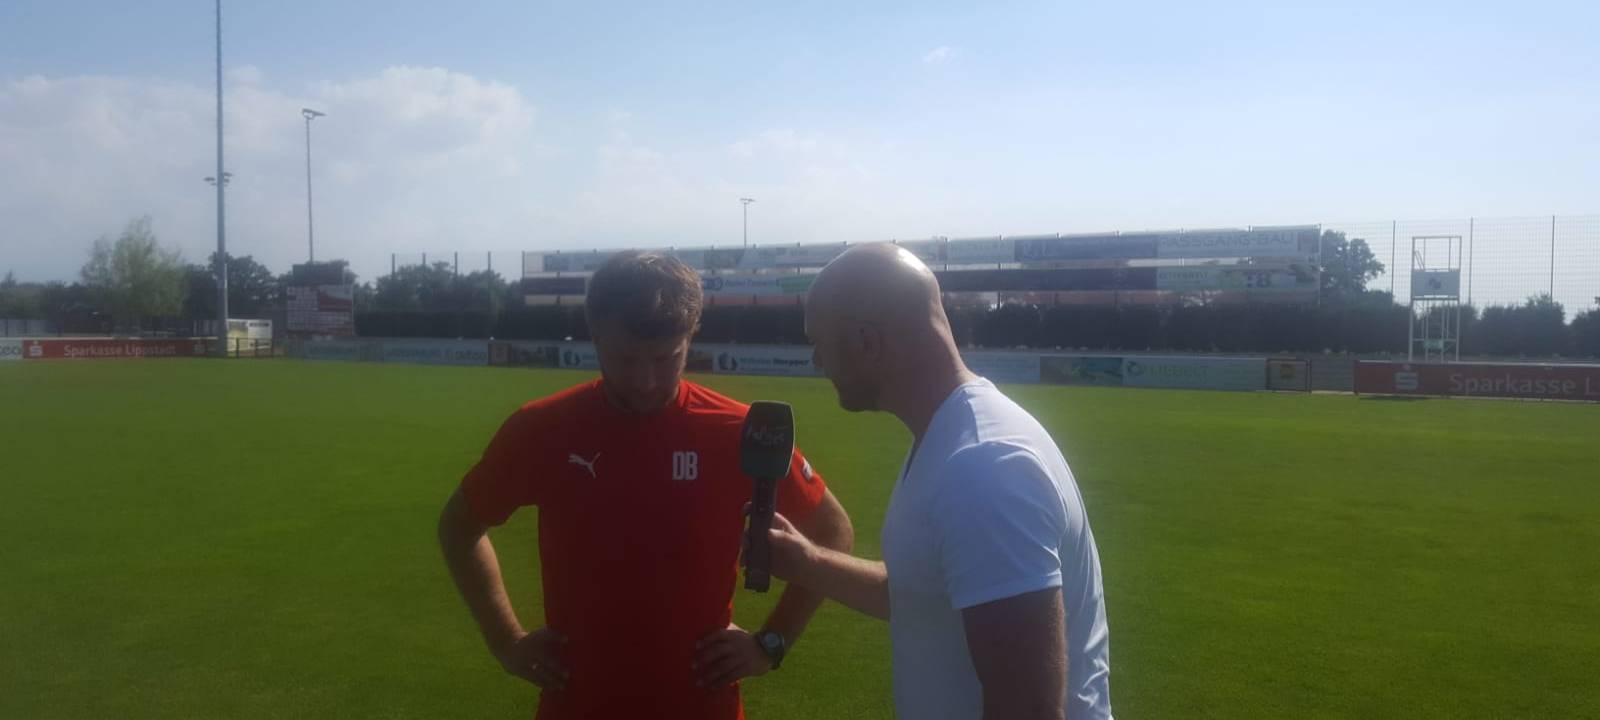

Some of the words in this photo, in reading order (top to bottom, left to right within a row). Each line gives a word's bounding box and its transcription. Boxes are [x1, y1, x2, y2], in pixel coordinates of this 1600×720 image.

[63, 345, 121, 357] Sparkasse
[125, 344, 177, 357] Lippstadt
[1449, 372, 1577, 395] Sparkasse
[672, 451, 698, 481] DB
